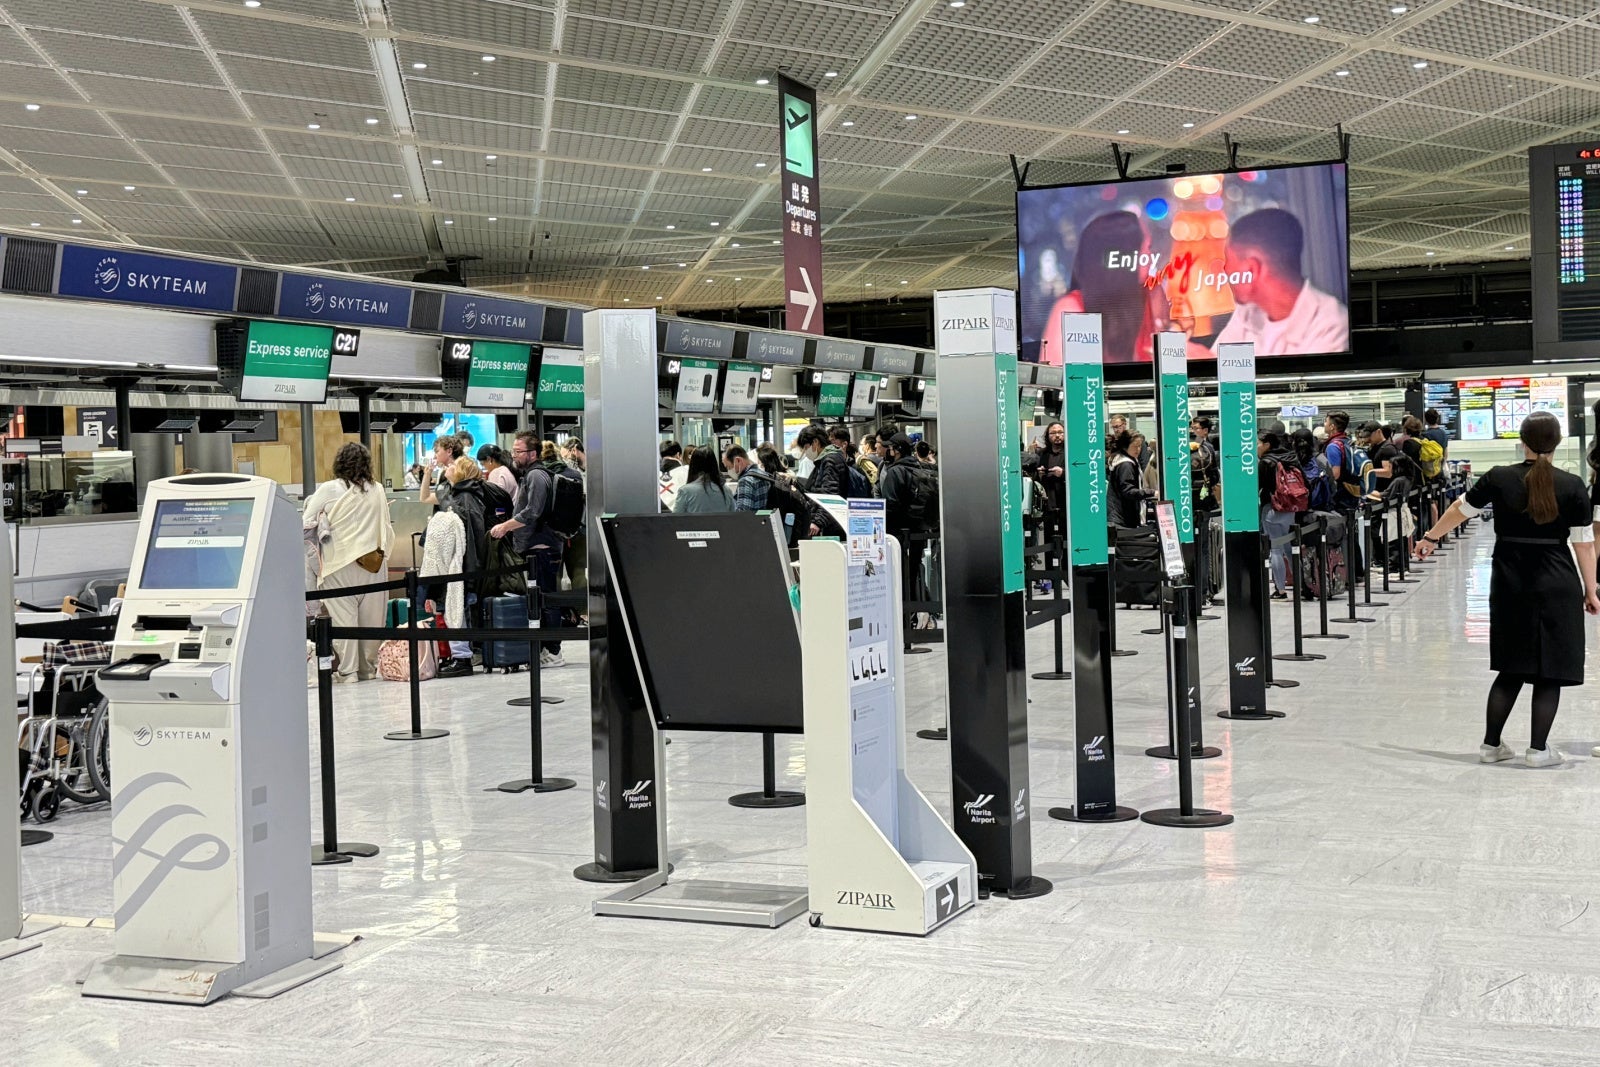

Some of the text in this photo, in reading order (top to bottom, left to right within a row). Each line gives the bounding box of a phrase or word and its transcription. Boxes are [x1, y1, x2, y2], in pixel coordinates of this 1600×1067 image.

[791, 182, 810, 204] 出発
[786, 200, 816, 221] Departures
[1108, 250, 1160, 272] Enjoy
[1194, 269, 1253, 291] Japan
[127, 272, 208, 295] SKYTEAM
[329, 295, 389, 314] SKYTEAM
[480, 313, 526, 329] SKYTEAM
[942, 317, 990, 330] ZIPAIR
[995, 316, 1015, 331] ZIPAIR
[335, 332, 358, 352] C21
[691, 337, 722, 349] SKYTEAM
[1066, 332, 1100, 344] ZIPAIR
[248, 340, 330, 359] Express service
[452, 342, 472, 360] C22
[768, 344, 794, 356] SKYTEAM
[1162, 347, 1186, 357] ZIPAIR
[471, 357, 528, 372] Express service
[1221, 359, 1253, 368] ZIPAIR
[274, 384, 296, 394] ZIPAIR
[539, 379, 554, 392] San
[1239, 391, 1254, 475] BAG DROP
[997, 369, 1012, 532] Express Service
[1083, 375, 1104, 513] Express Service
[1175, 384, 1192, 534] SAN FRANCISCO
[156, 730, 211, 740] SKYTEAM
[628, 801, 652, 810] Airport
[970, 808, 992, 816] Narita
[971, 815, 996, 825] Airport
[836, 890, 896, 910] ZIPAIR
